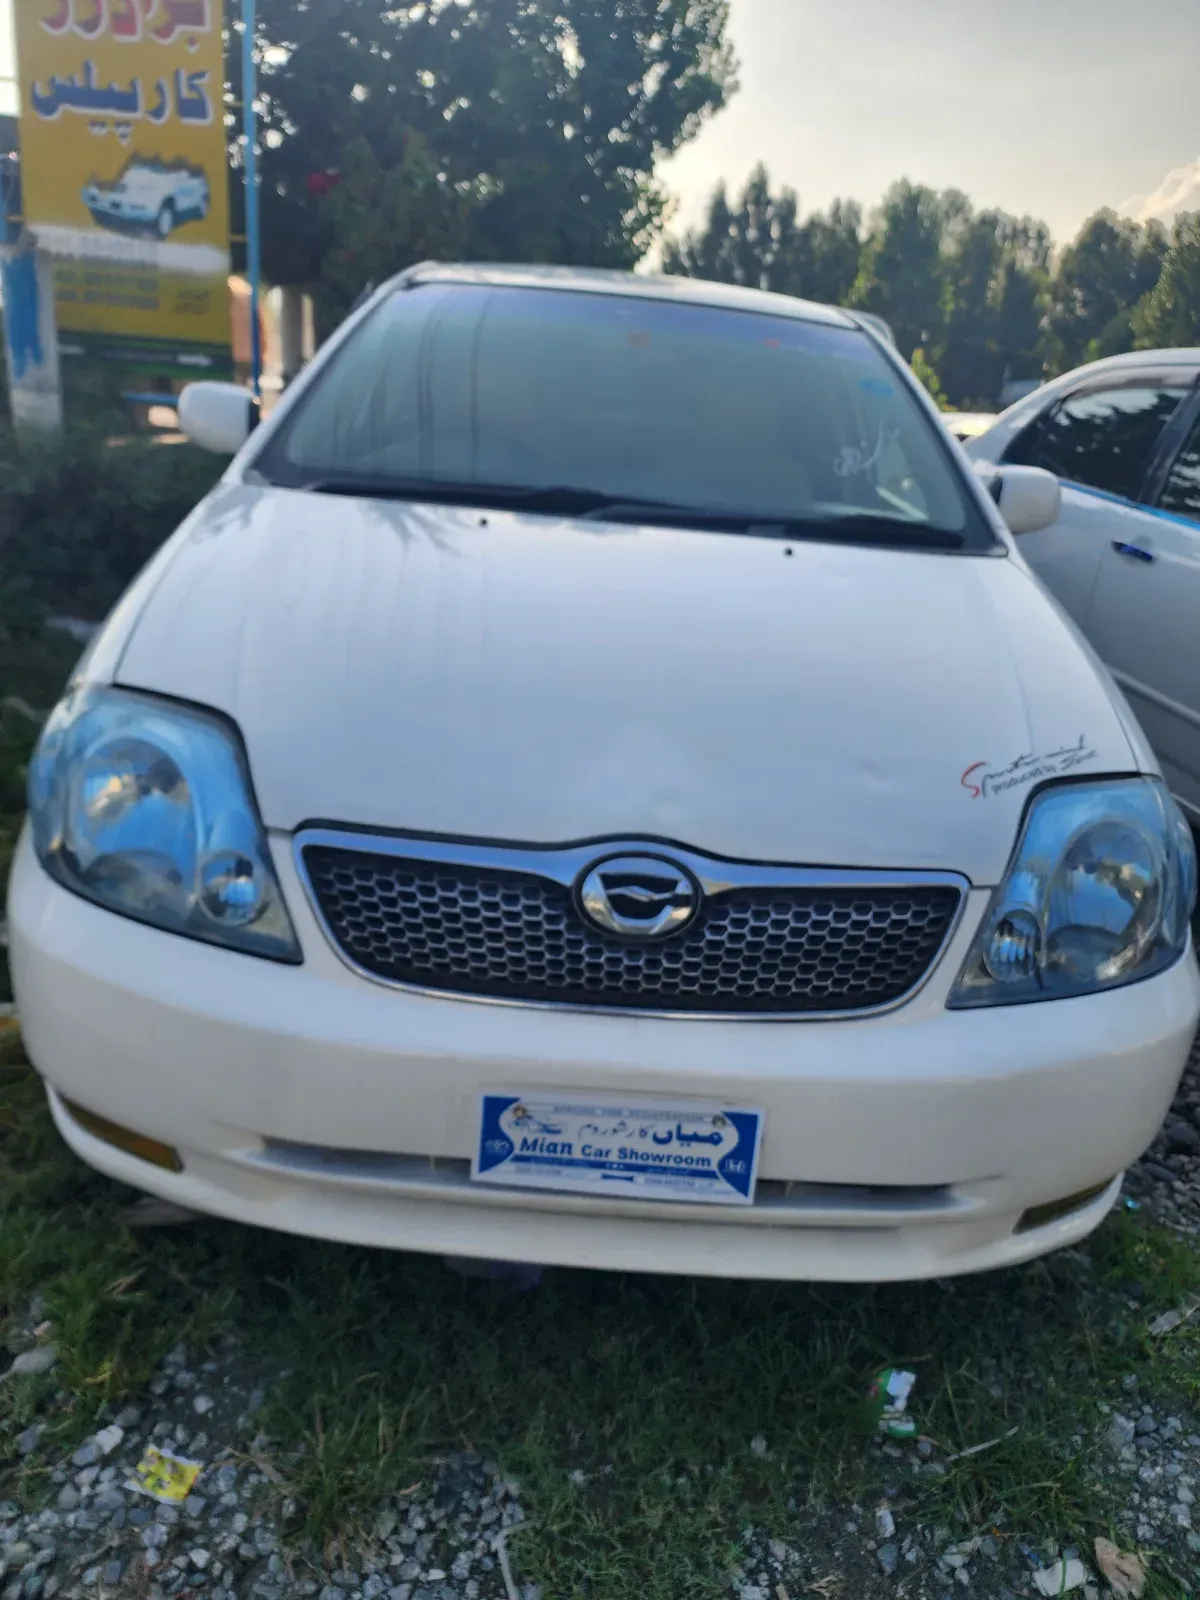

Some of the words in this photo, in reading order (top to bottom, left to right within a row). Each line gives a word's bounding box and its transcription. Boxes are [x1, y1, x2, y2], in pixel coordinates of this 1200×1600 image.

[520, 1136, 573, 1156] Mian
[581, 1144, 611, 1159] Car
[617, 1147, 712, 1168] Showroom
